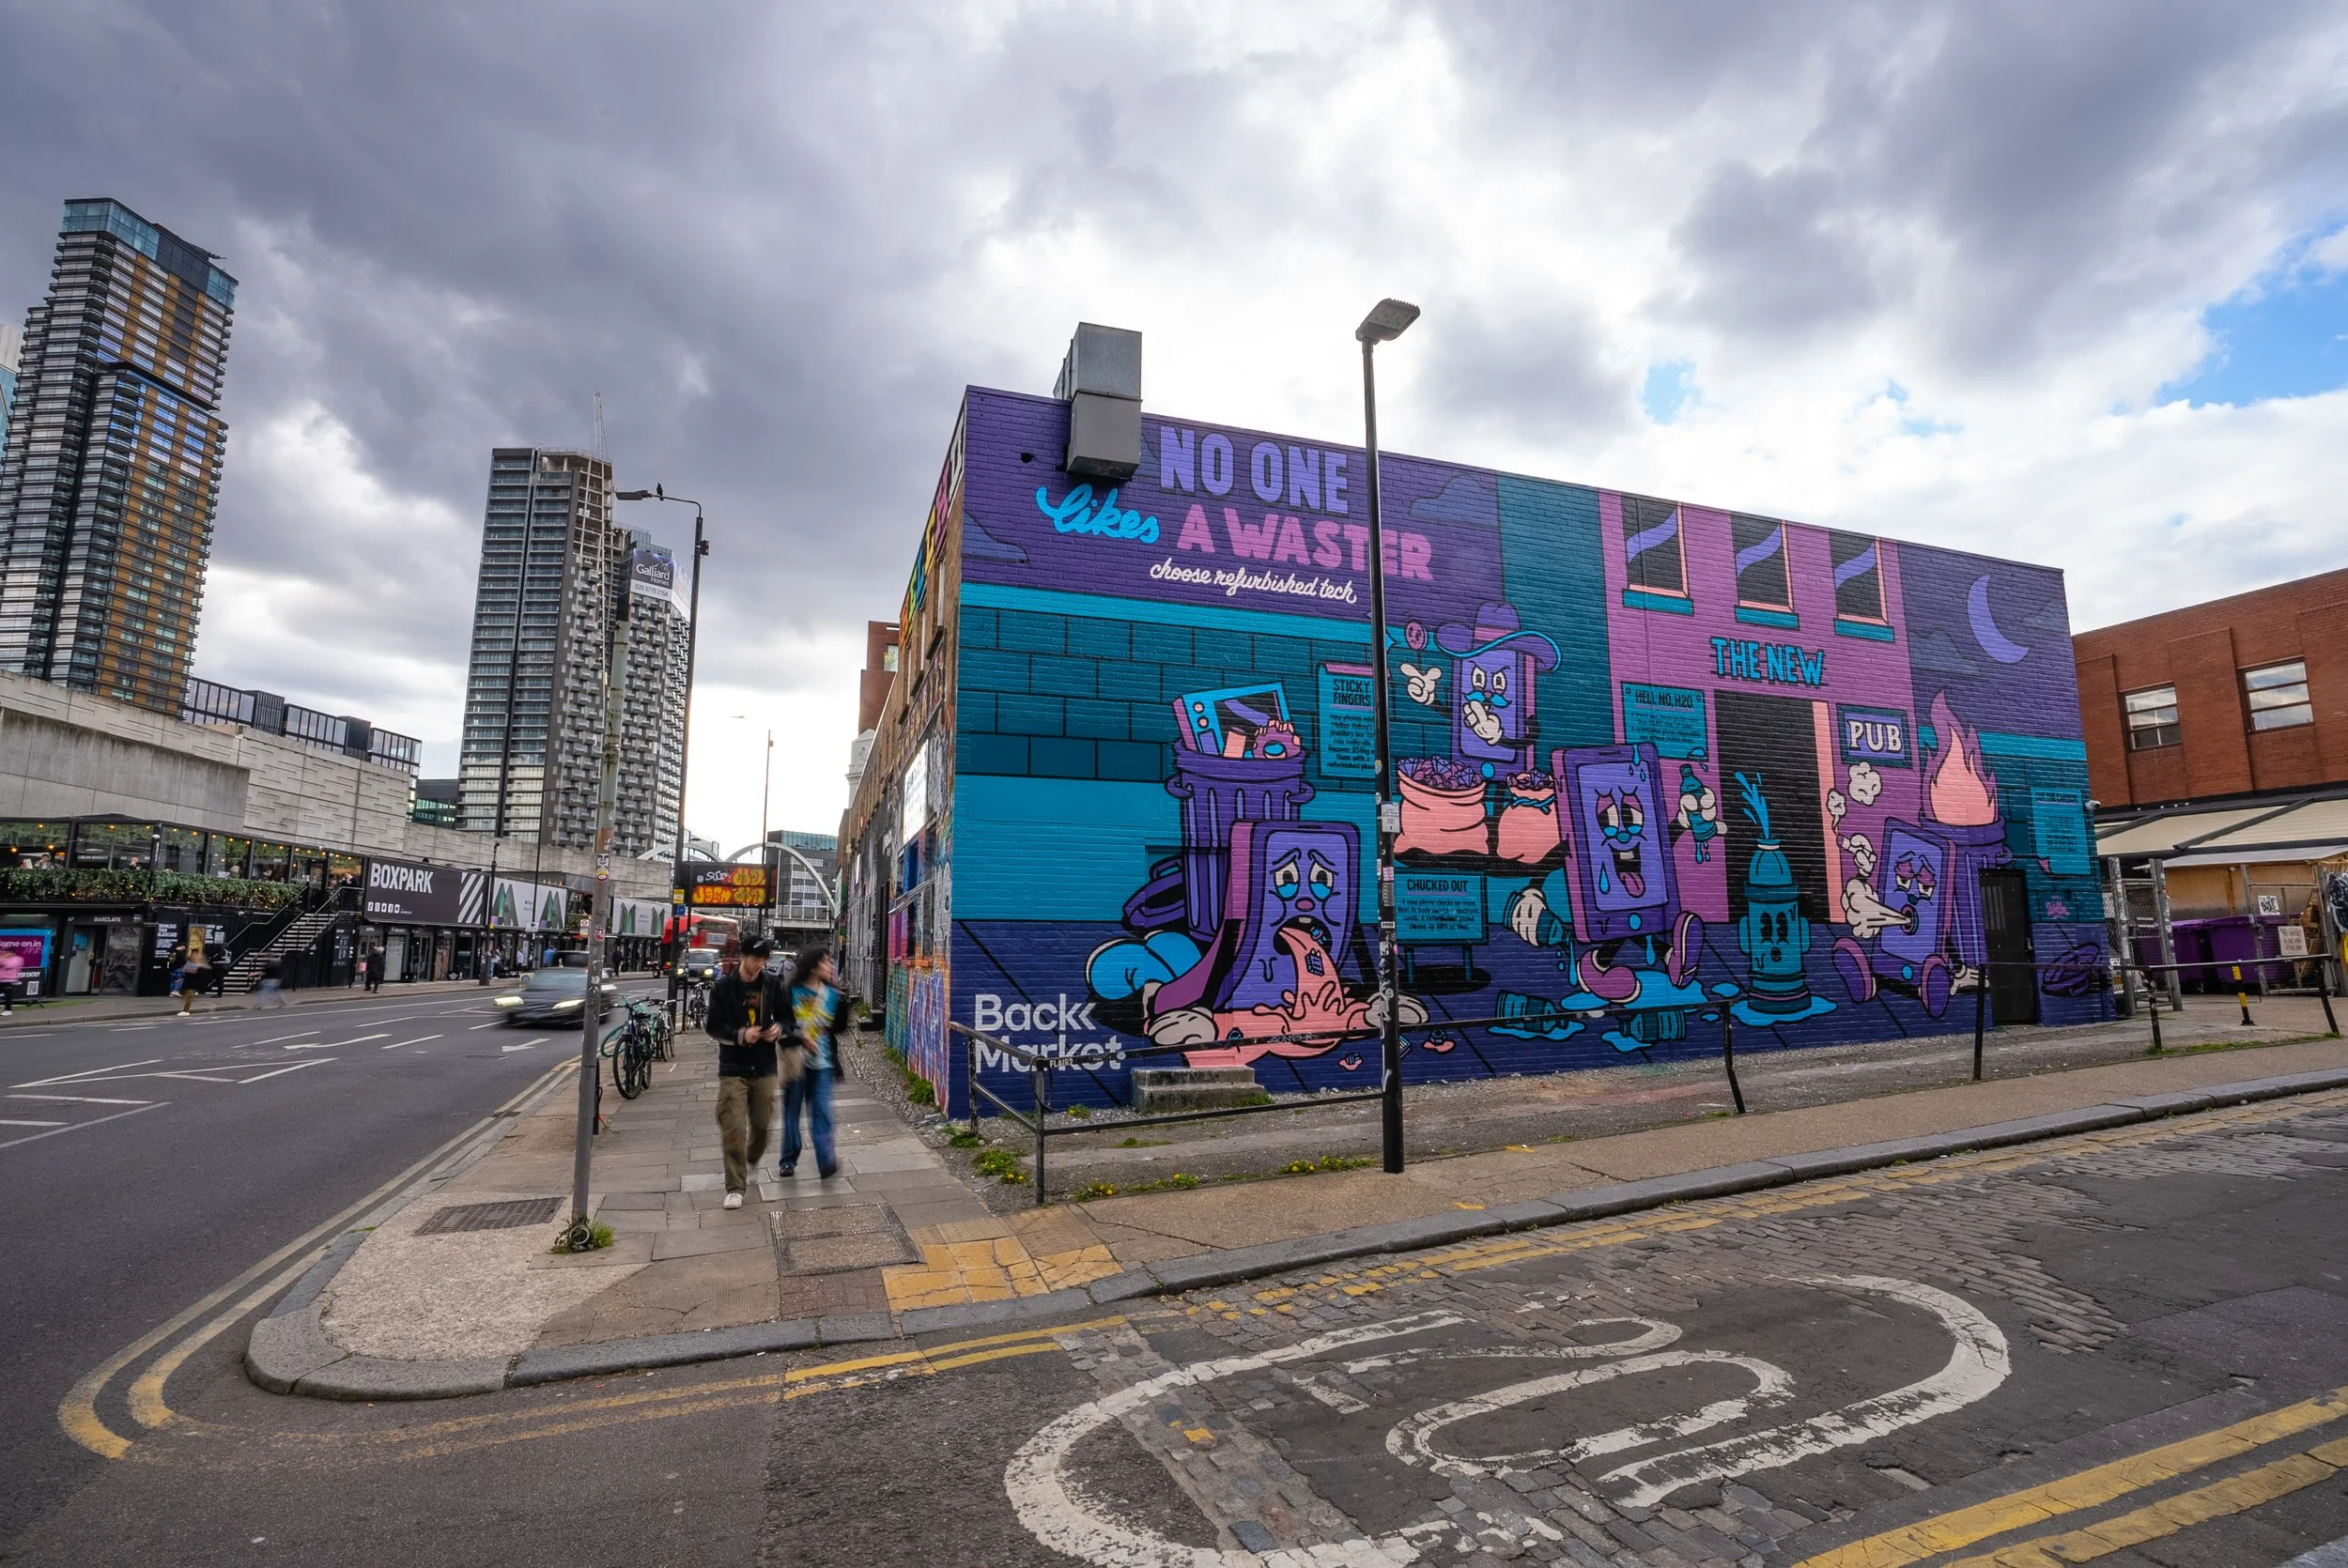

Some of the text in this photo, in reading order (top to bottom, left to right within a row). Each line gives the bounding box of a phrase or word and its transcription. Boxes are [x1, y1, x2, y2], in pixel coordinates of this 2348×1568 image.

[1160, 425, 1350, 515] NO ONE
[1035, 483, 1160, 545] likes
[1177, 504, 1434, 581] A WASTER
[636, 563, 671, 581] Galliard
[651, 576, 670, 587] Homes
[1150, 558, 1212, 584] choose
[1213, 568, 1319, 597] refurbished
[1710, 637, 1825, 686] THE NEW
[1334, 678, 1369, 694] STICKY
[1334, 692, 1371, 706] FINGERS
[1635, 690, 1656, 704] HELL
[1847, 718, 1903, 753] PUB
[370, 863, 434, 894] BOXPARK
[1407, 878, 1468, 892] CHUCKED OUT
[975, 992, 1096, 1032] Back
